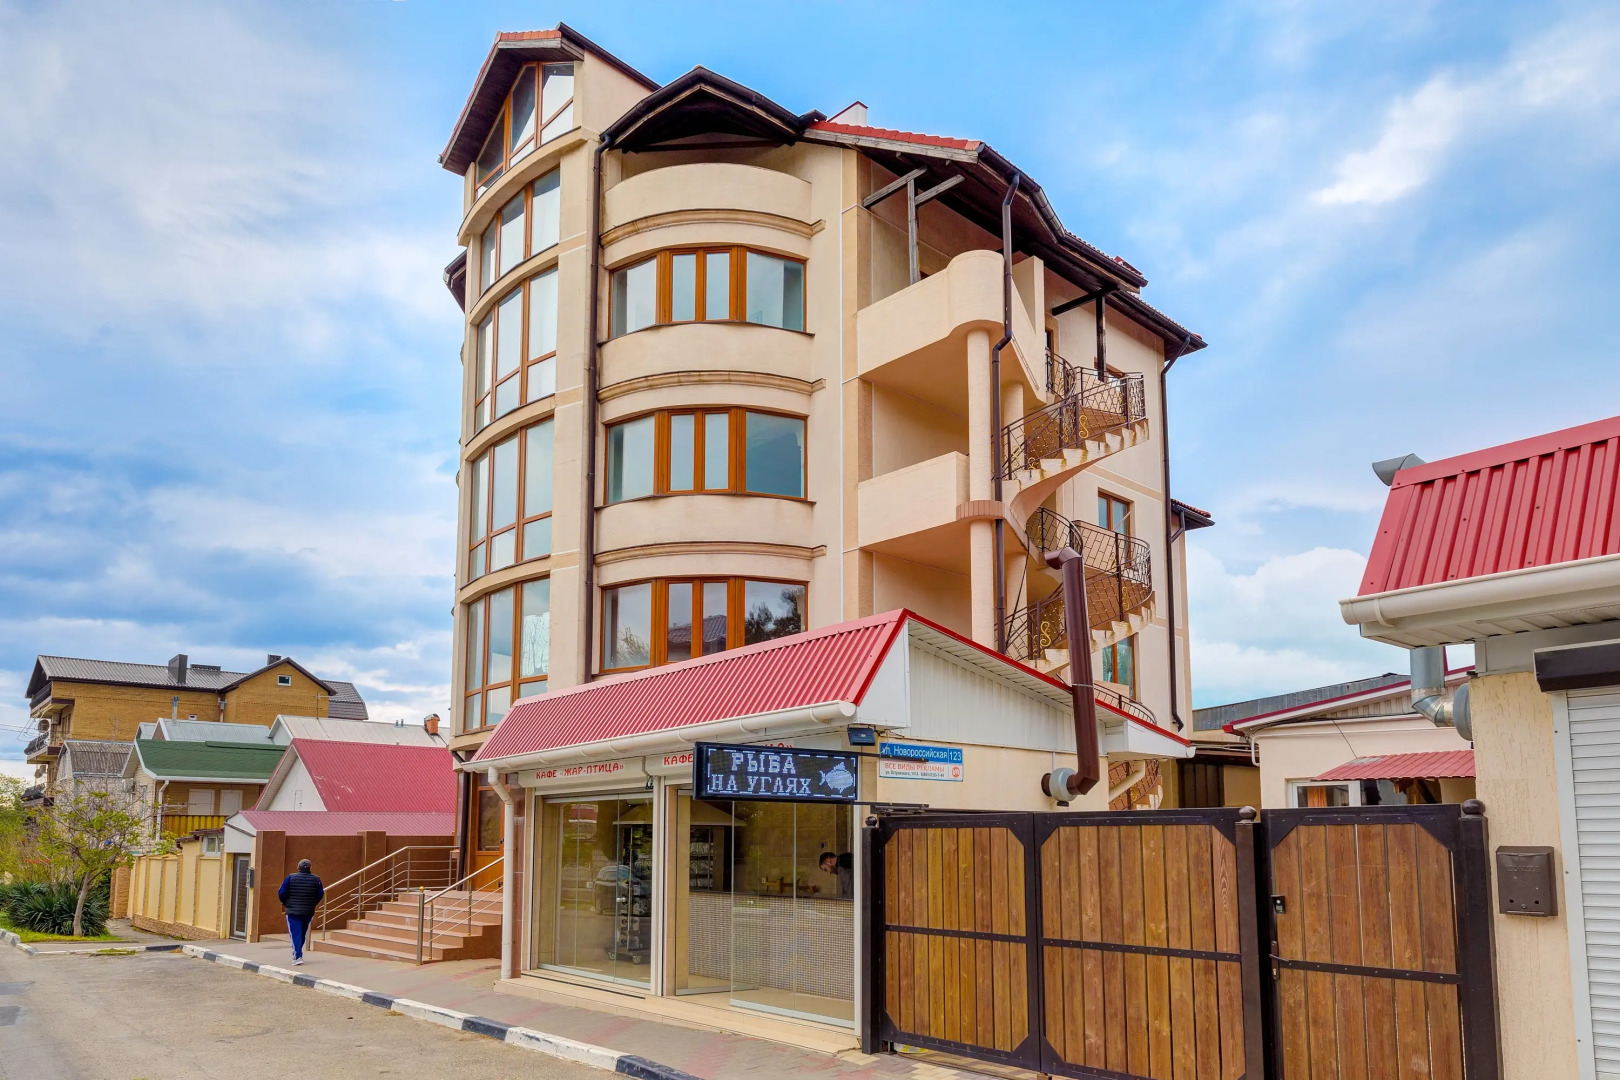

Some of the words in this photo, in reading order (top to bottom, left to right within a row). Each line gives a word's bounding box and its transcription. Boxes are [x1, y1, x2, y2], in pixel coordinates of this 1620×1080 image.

[663, 753, 694, 766] КАФЕ
[893, 746, 948, 759] Новороссийская
[949, 751, 962, 761] 123
[731, 752, 796, 774] РЫБА
[897, 763, 916, 772] ВИДЫ
[916, 765, 945, 773] РЕКЛАМЫ
[536, 769, 557, 779] КАФЕ
[711, 774, 738, 791] НА
[747, 775, 812, 794] УГЛЯХ
